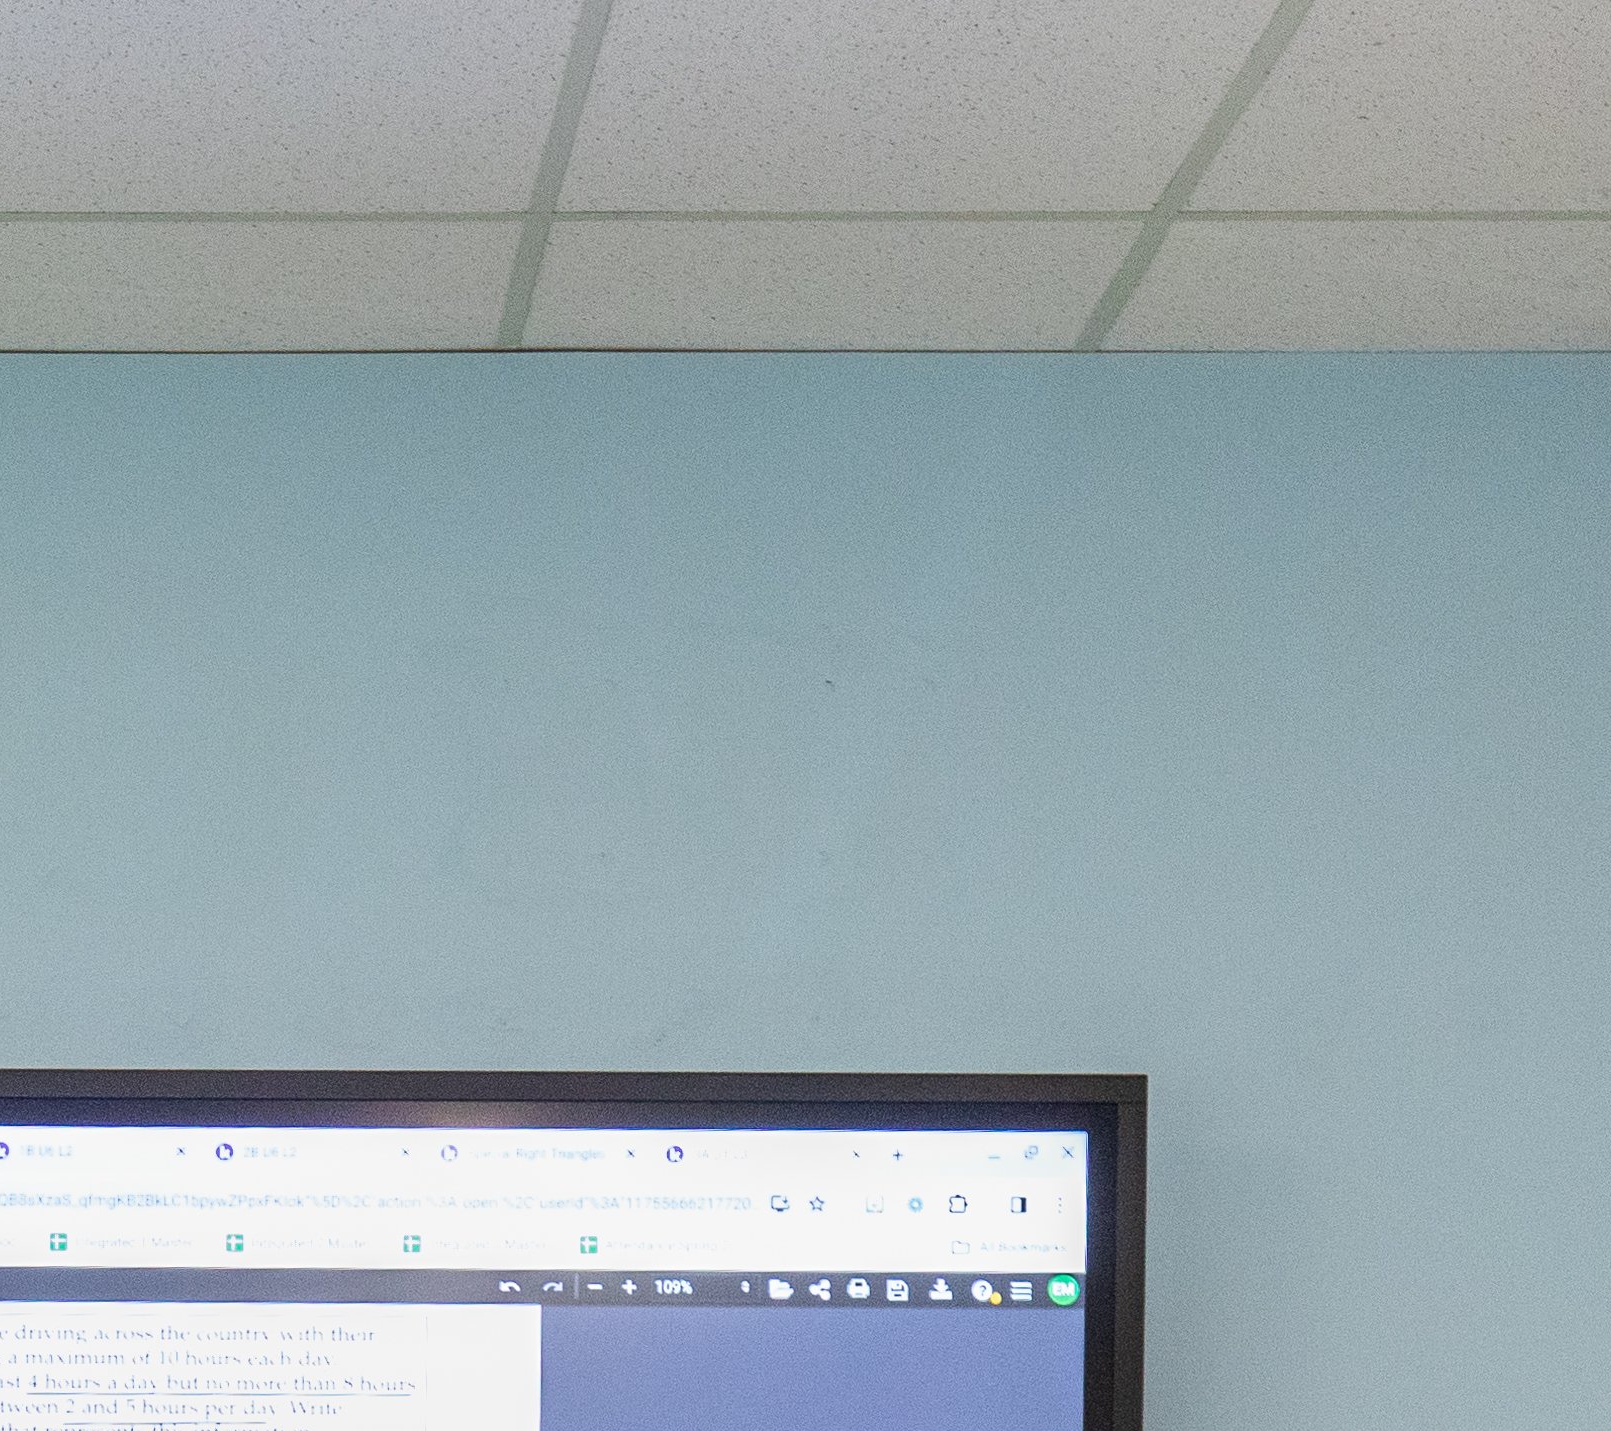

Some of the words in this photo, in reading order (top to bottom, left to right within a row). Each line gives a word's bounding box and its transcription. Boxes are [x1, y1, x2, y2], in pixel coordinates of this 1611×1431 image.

[655, 1280, 693, 1295] 109%
[15, 1324, 87, 1342] driving
[160, 1326, 191, 1341] the
